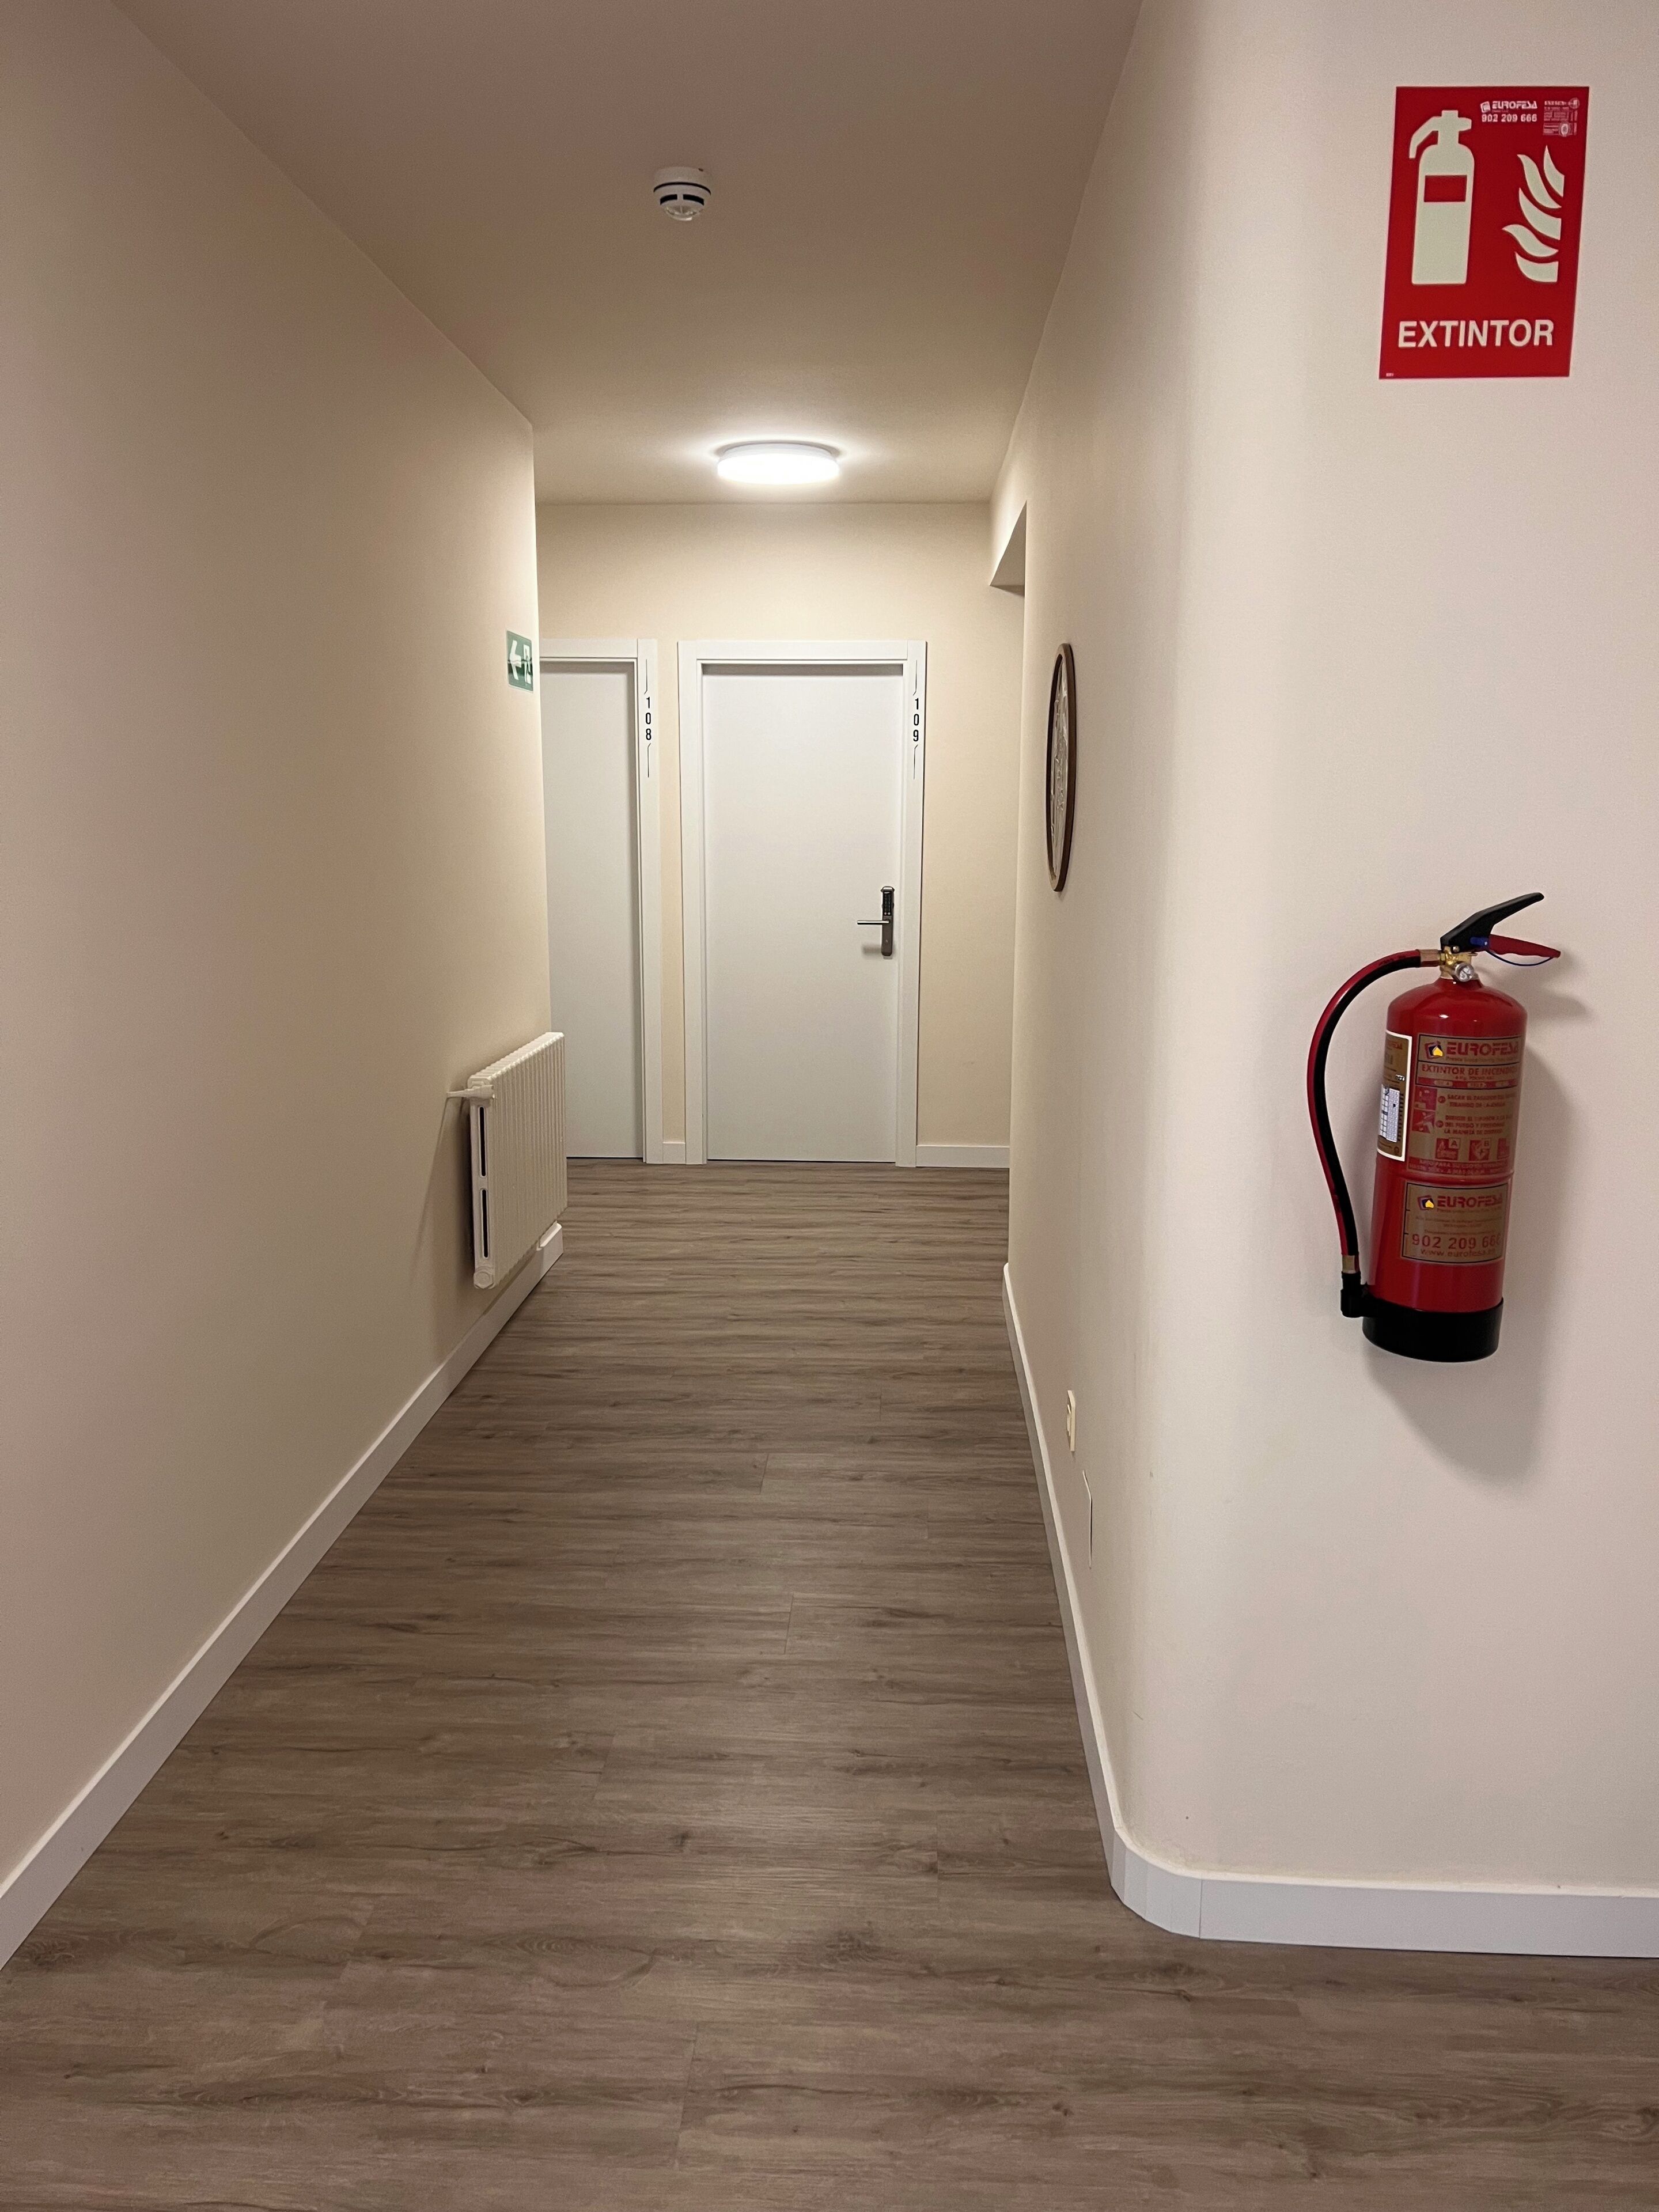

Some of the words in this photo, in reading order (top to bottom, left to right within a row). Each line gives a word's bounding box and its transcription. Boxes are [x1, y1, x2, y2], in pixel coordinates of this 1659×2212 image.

[1492, 100, 1537, 109] EUROFESA
[1482, 113, 1498, 122] 902
[1501, 113, 1518, 122] 209
[1520, 113, 1537, 122] 666
[1397, 319, 1554, 348] EXTINTOR
[1446, 1040, 1519, 1056] EUROFESA
[1422, 1064, 1465, 1075] EXTINTOR
[1437, 1193, 1502, 1208] EUROFESA
[1412, 1234, 1441, 1248] 902
[1448, 1237, 1476, 1249] 209
